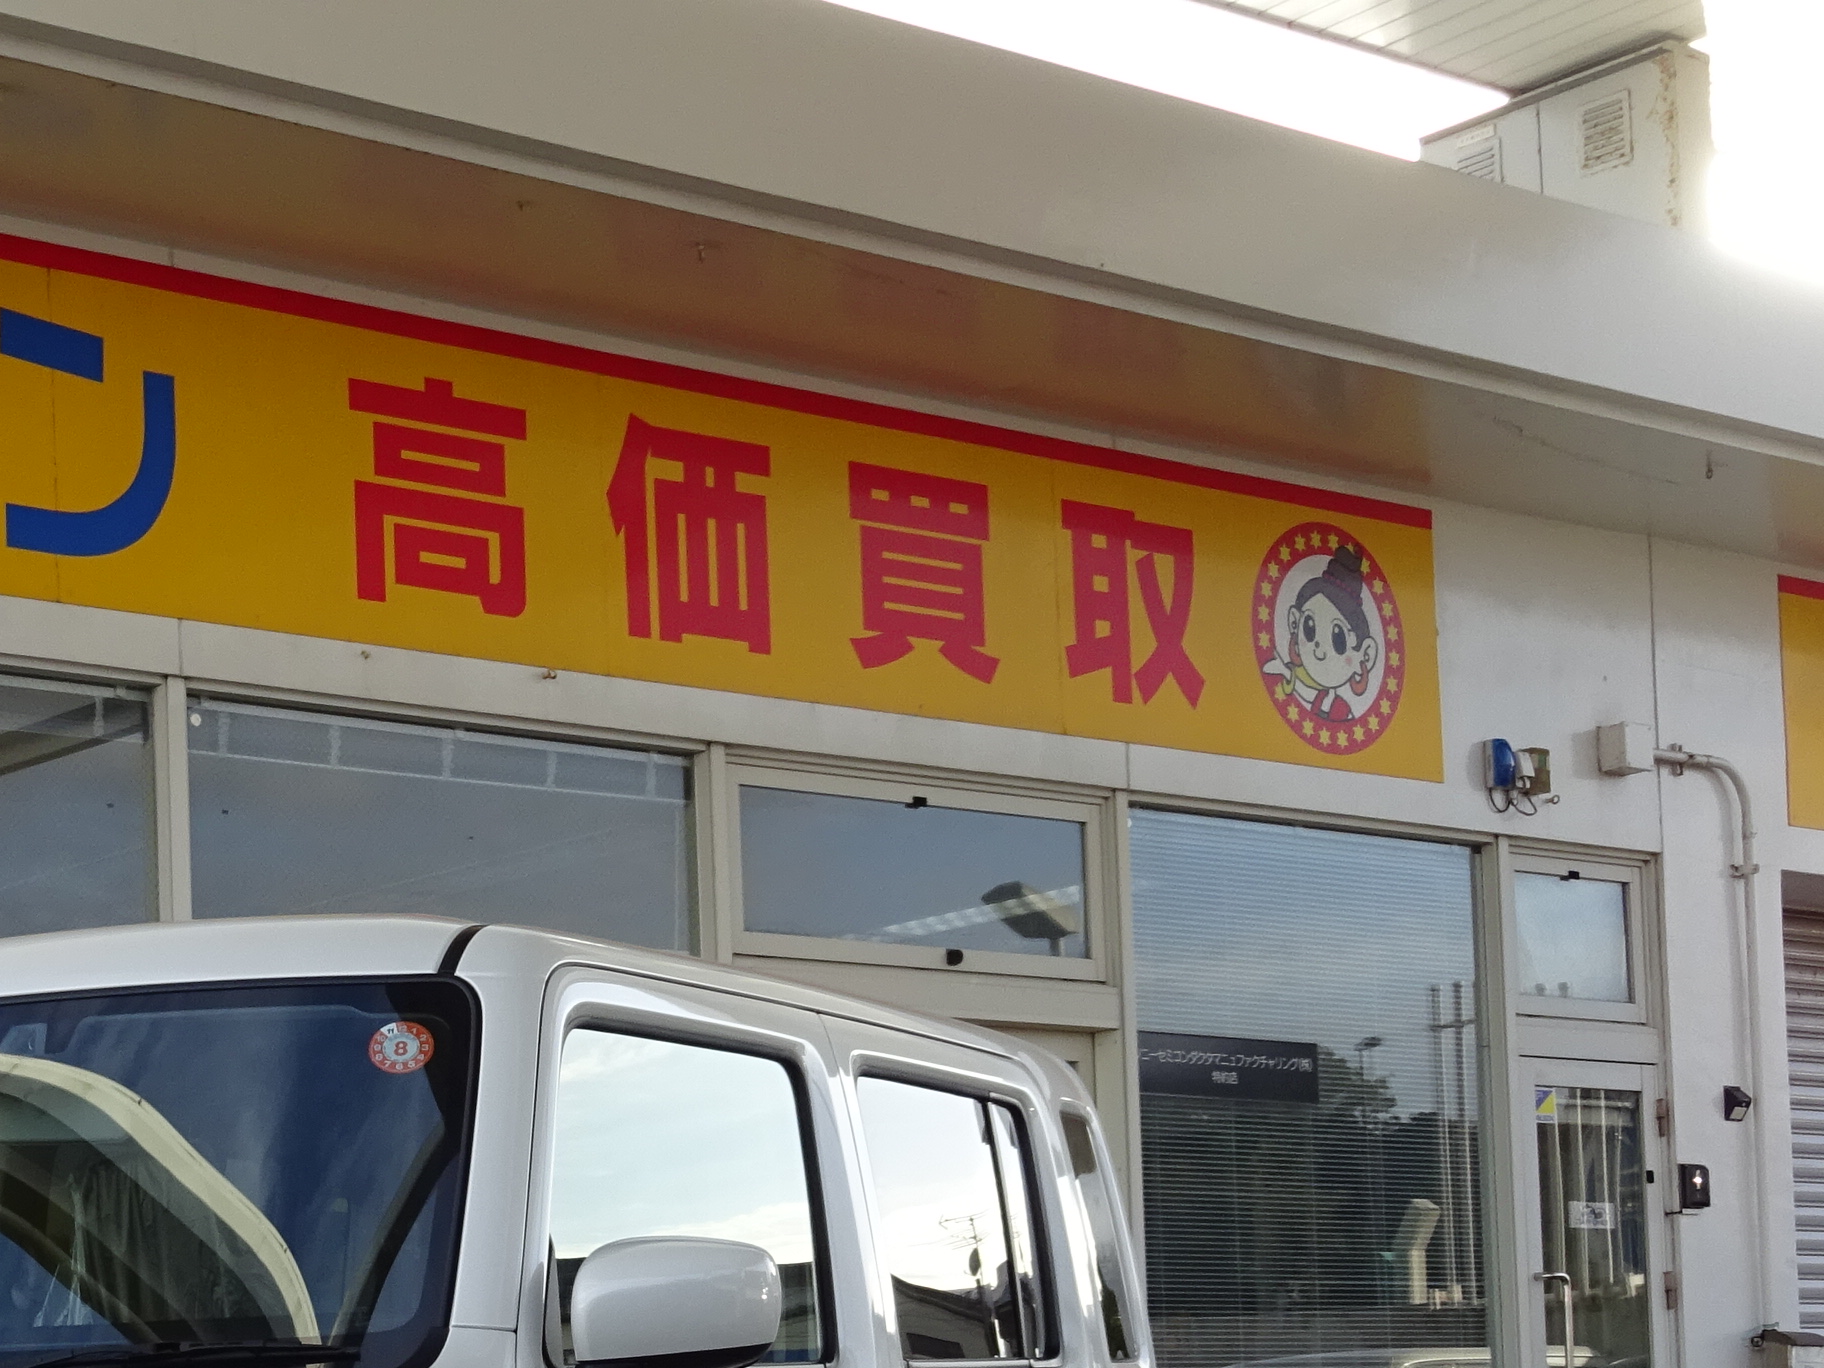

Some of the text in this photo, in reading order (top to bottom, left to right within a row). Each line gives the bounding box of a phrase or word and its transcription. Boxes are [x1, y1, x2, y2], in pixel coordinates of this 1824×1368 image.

[347, 376, 1206, 710] 高価買取
[393, 1040, 408, 1056] 8
